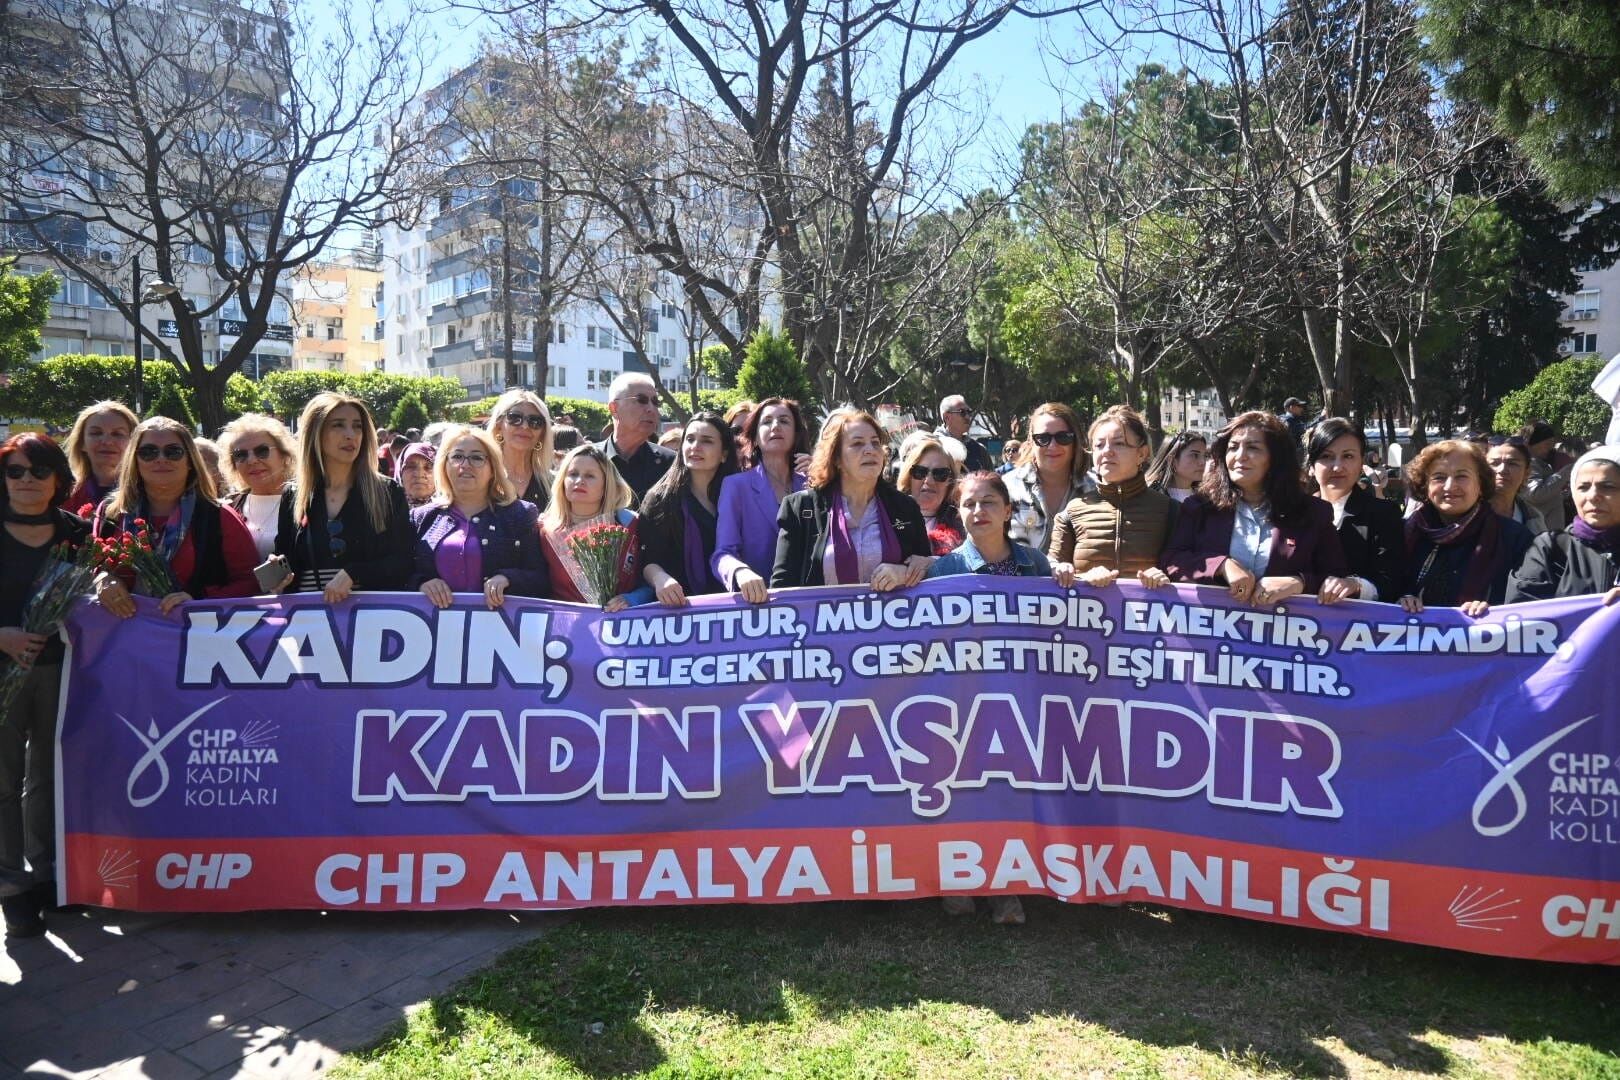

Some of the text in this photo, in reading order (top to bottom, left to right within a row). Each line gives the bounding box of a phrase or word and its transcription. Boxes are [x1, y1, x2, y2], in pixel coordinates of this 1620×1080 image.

[602, 590, 1574, 660] UMUTTUR, MÜCADELEDİR, EMEKTİR, AZİMDİR.
[183, 609, 568, 698] KADIN;
[597, 634, 1350, 696] GELECEKTİR, CESARETTİR, EŞİTLİKTİR.
[188, 729, 237, 748] CHP
[187, 748, 279, 764] ANTALYA
[354, 694, 1343, 817] KADIN YAŞAMDIR
[1549, 752, 1610, 775] CHP
[186, 766, 260, 784] KADIN
[1549, 776, 1620, 795] ANTA
[185, 788, 277, 806] KOLLARI
[1550, 795, 1618, 818] KADI
[1550, 821, 1620, 844] KOLL
[156, 853, 252, 889] CHP
[315, 830, 1389, 931] CHP ANTALYA İL BAŞKANLIĞI
